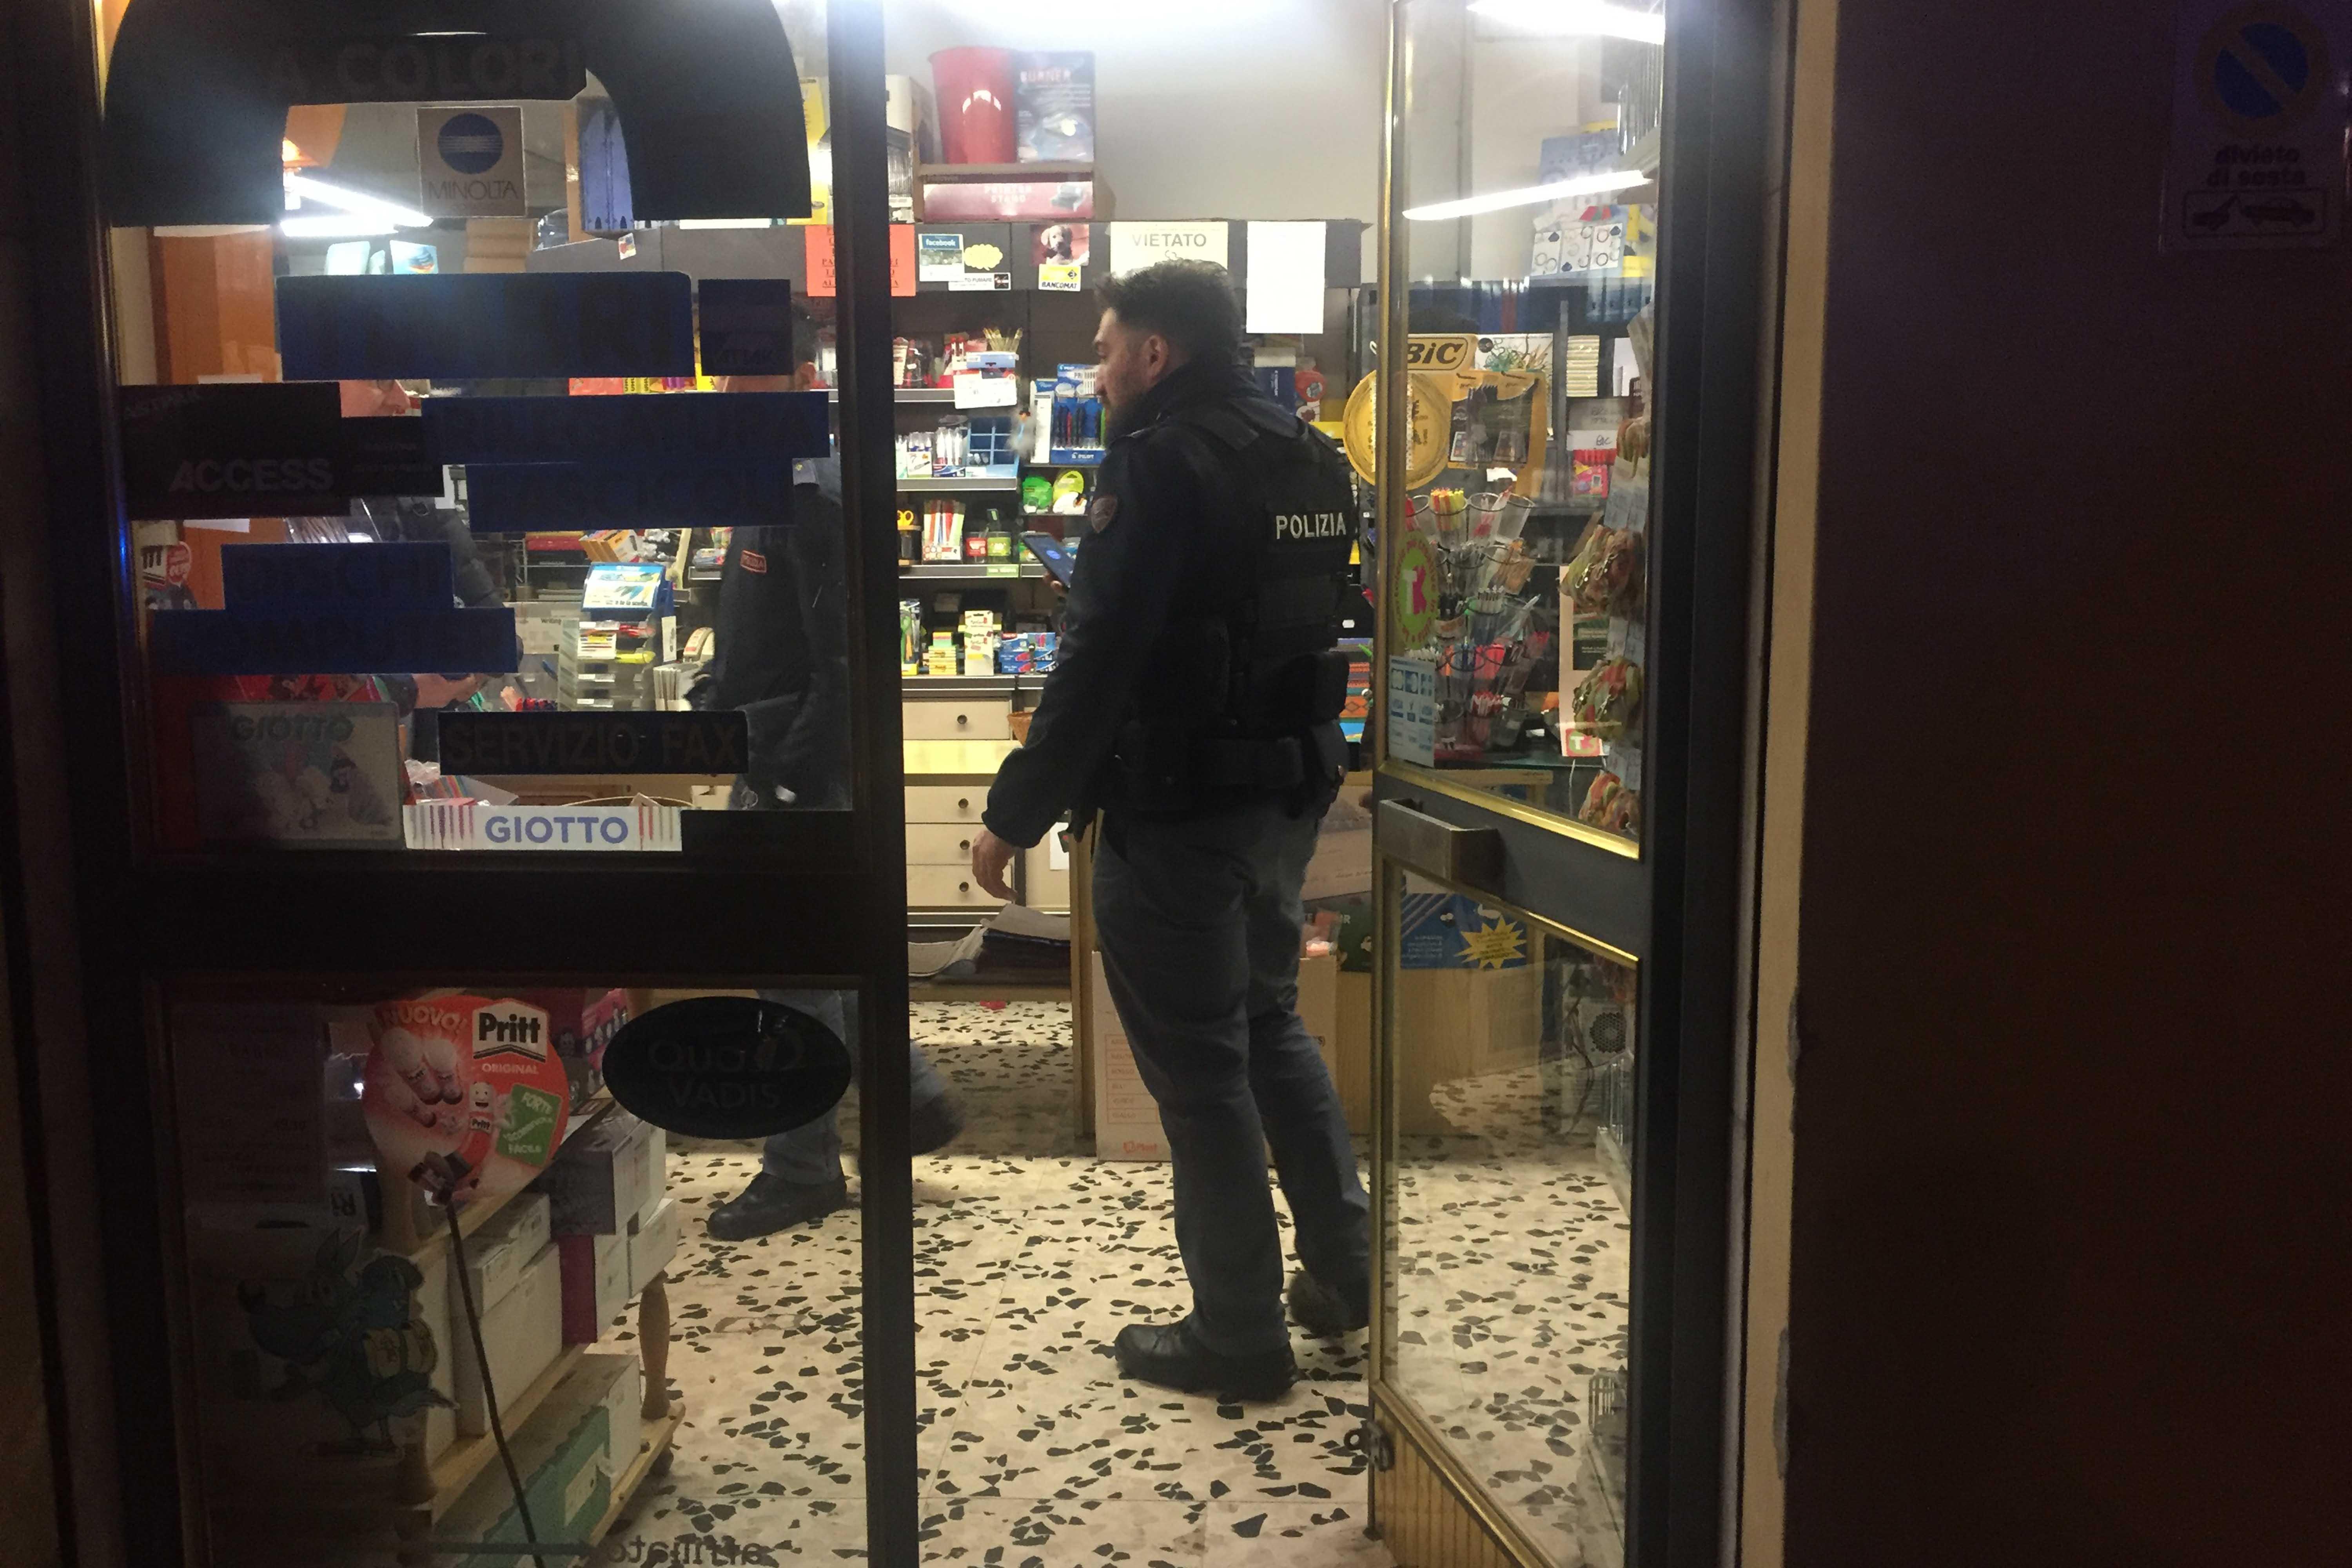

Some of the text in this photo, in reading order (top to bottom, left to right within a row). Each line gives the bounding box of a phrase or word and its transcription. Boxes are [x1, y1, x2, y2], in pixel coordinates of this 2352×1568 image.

[2214, 144, 2300, 163] divieto
[2207, 166, 2305, 186] di sosta
[428, 181, 519, 201] MINOLTA
[1132, 234, 1207, 247] VIETATO
[168, 457, 334, 493] ACCESS
[1276, 512, 1346, 539] POLIZIA
[232, 714, 354, 742] GIOTTO
[447, 723, 740, 768] SERVIZIO FAX
[485, 816, 628, 844] GIOTTO
[479, 1013, 541, 1043] Pritt
[482, 1063, 539, 1074] ORIGINAL
[666, 1077, 780, 1109] VADIS
